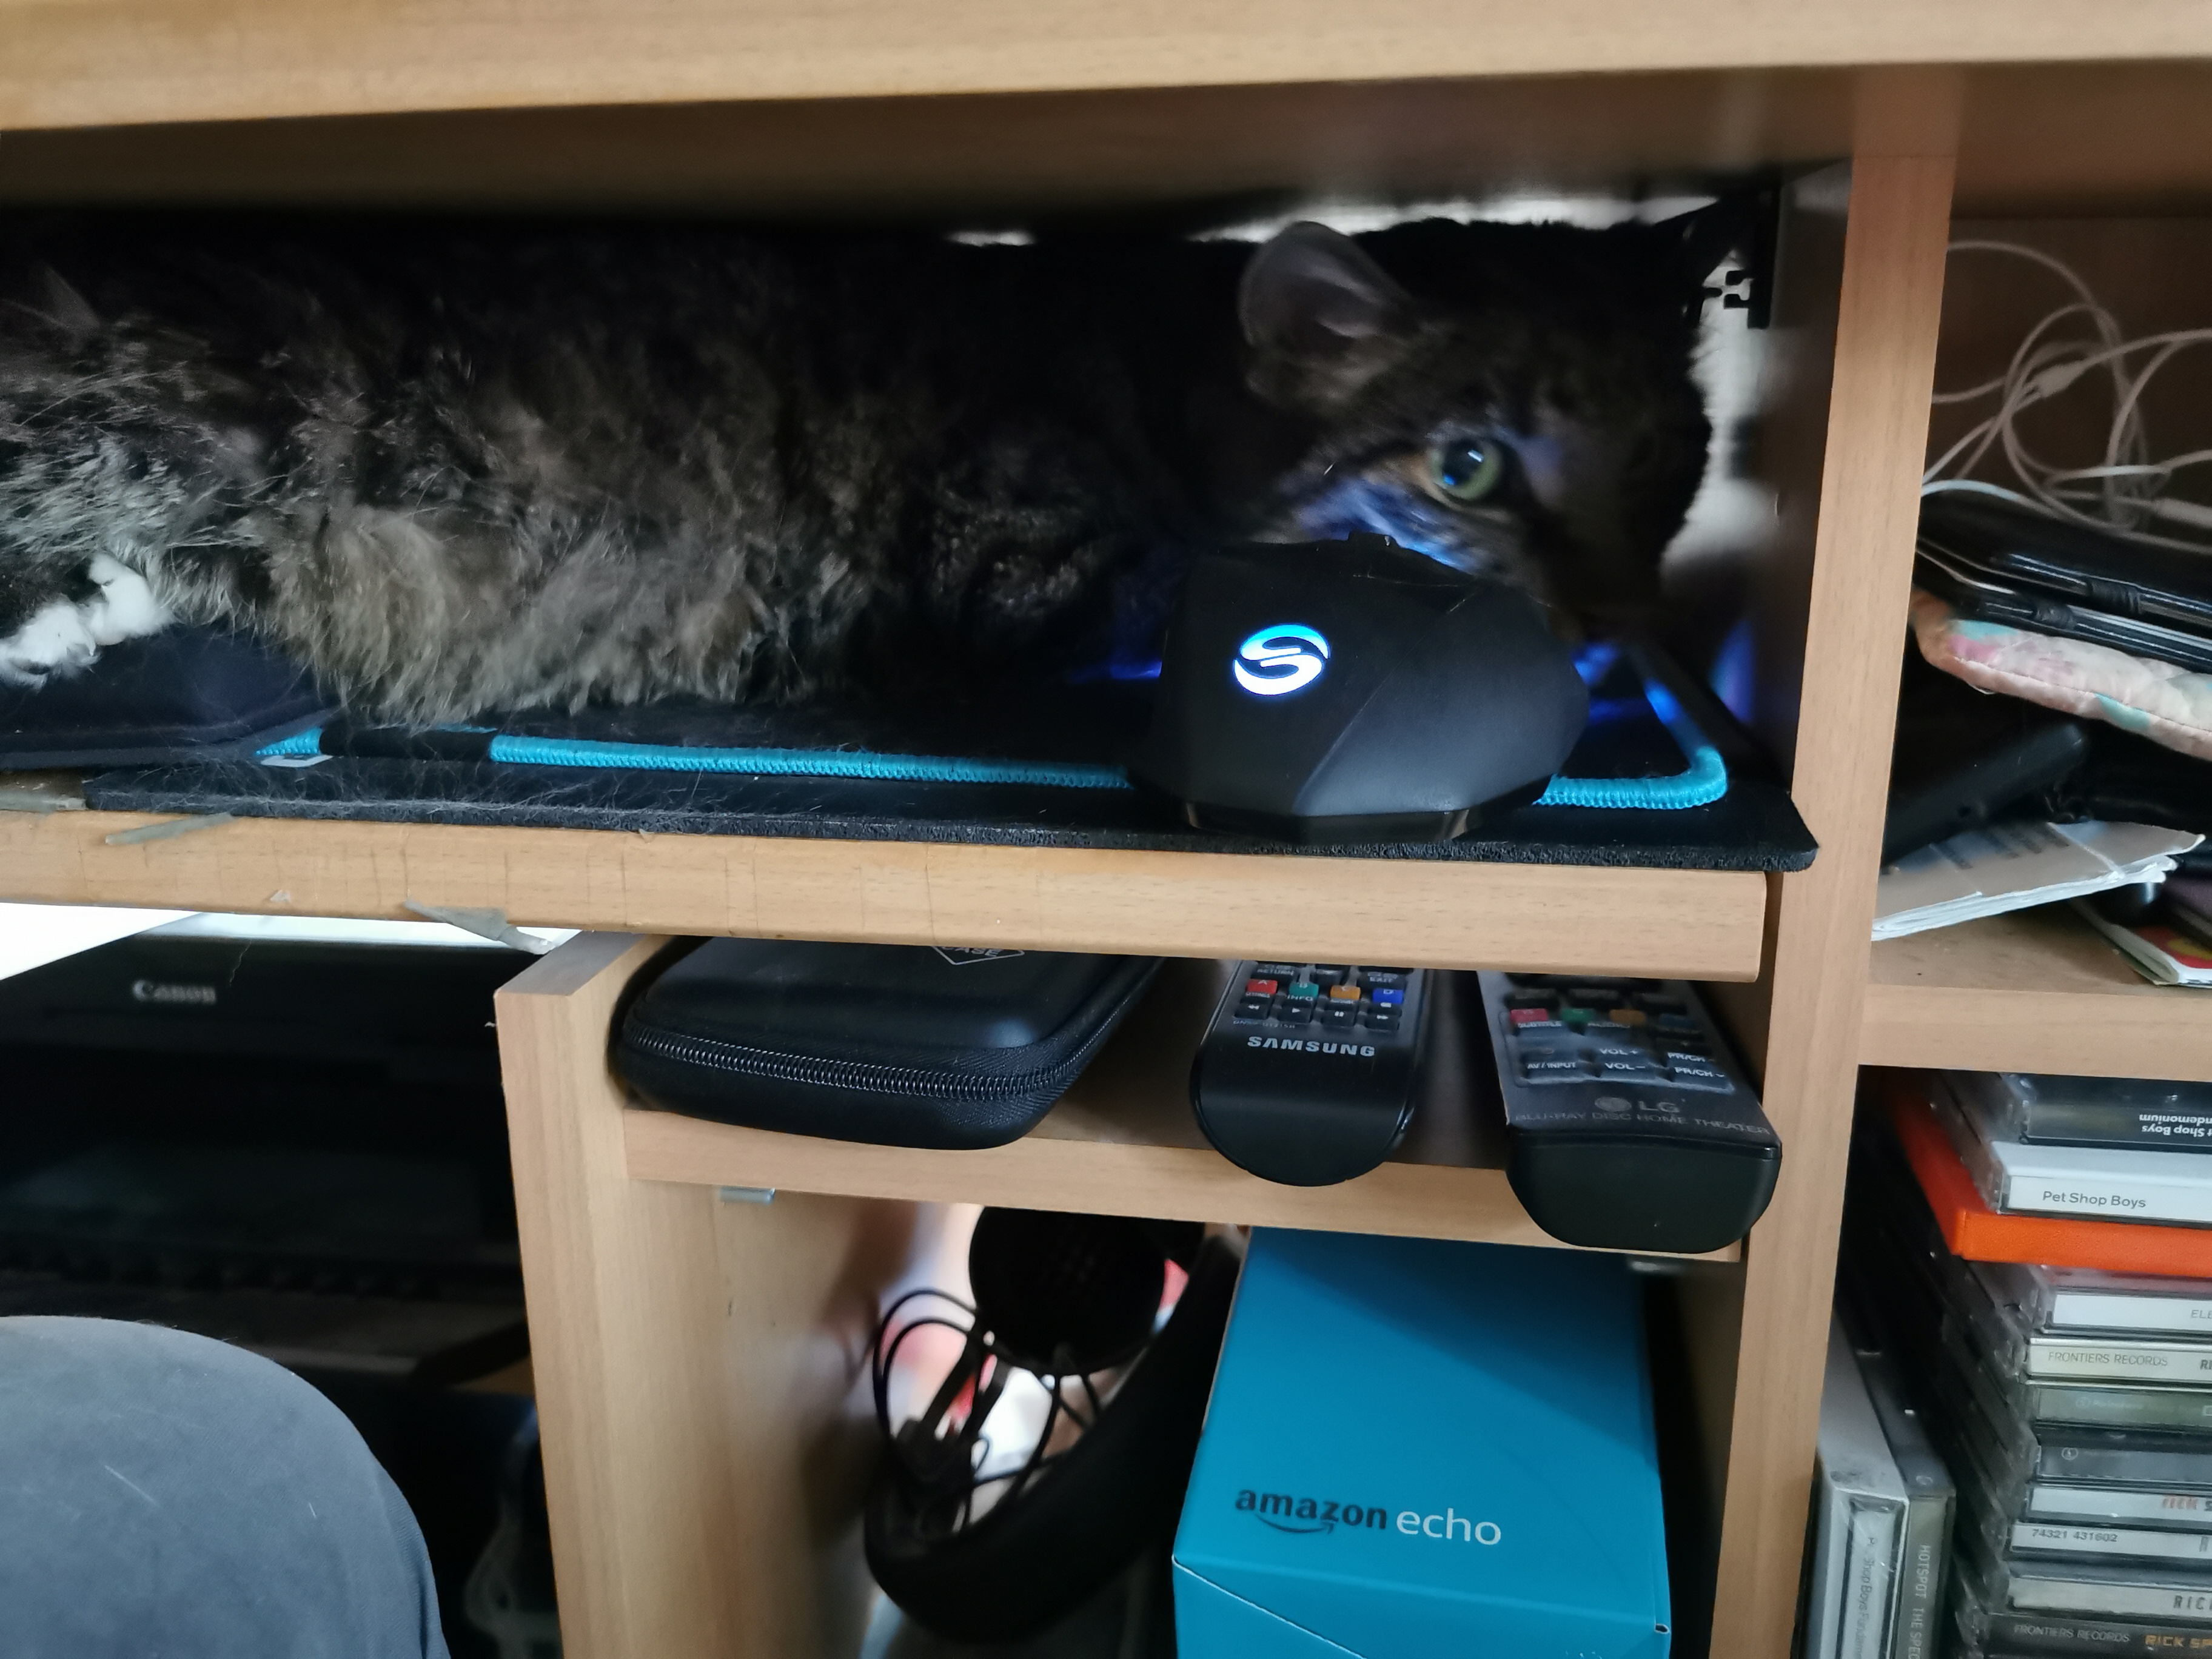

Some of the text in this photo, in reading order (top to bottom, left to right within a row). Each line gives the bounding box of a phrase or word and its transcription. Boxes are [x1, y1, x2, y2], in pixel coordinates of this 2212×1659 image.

[1247, 1036, 1375, 1056] SAMSUNG
[1639, 1101, 1680, 1113] LG
[2142, 1123, 2171, 1136] Boys
[2173, 1124, 2205, 1138] Shop
[2043, 1190, 2147, 1210] Pet Shop Boys
[2048, 1352, 2110, 1364] FRONTIERS
[2114, 1354, 2168, 1367] RECORDS
[1235, 1489, 1502, 1546] amazon echo
[2032, 1528, 2118, 1543] 74321 431602
[1915, 1545, 1931, 1599] HOTSPOT
[1911, 1608, 1925, 1629] THE
